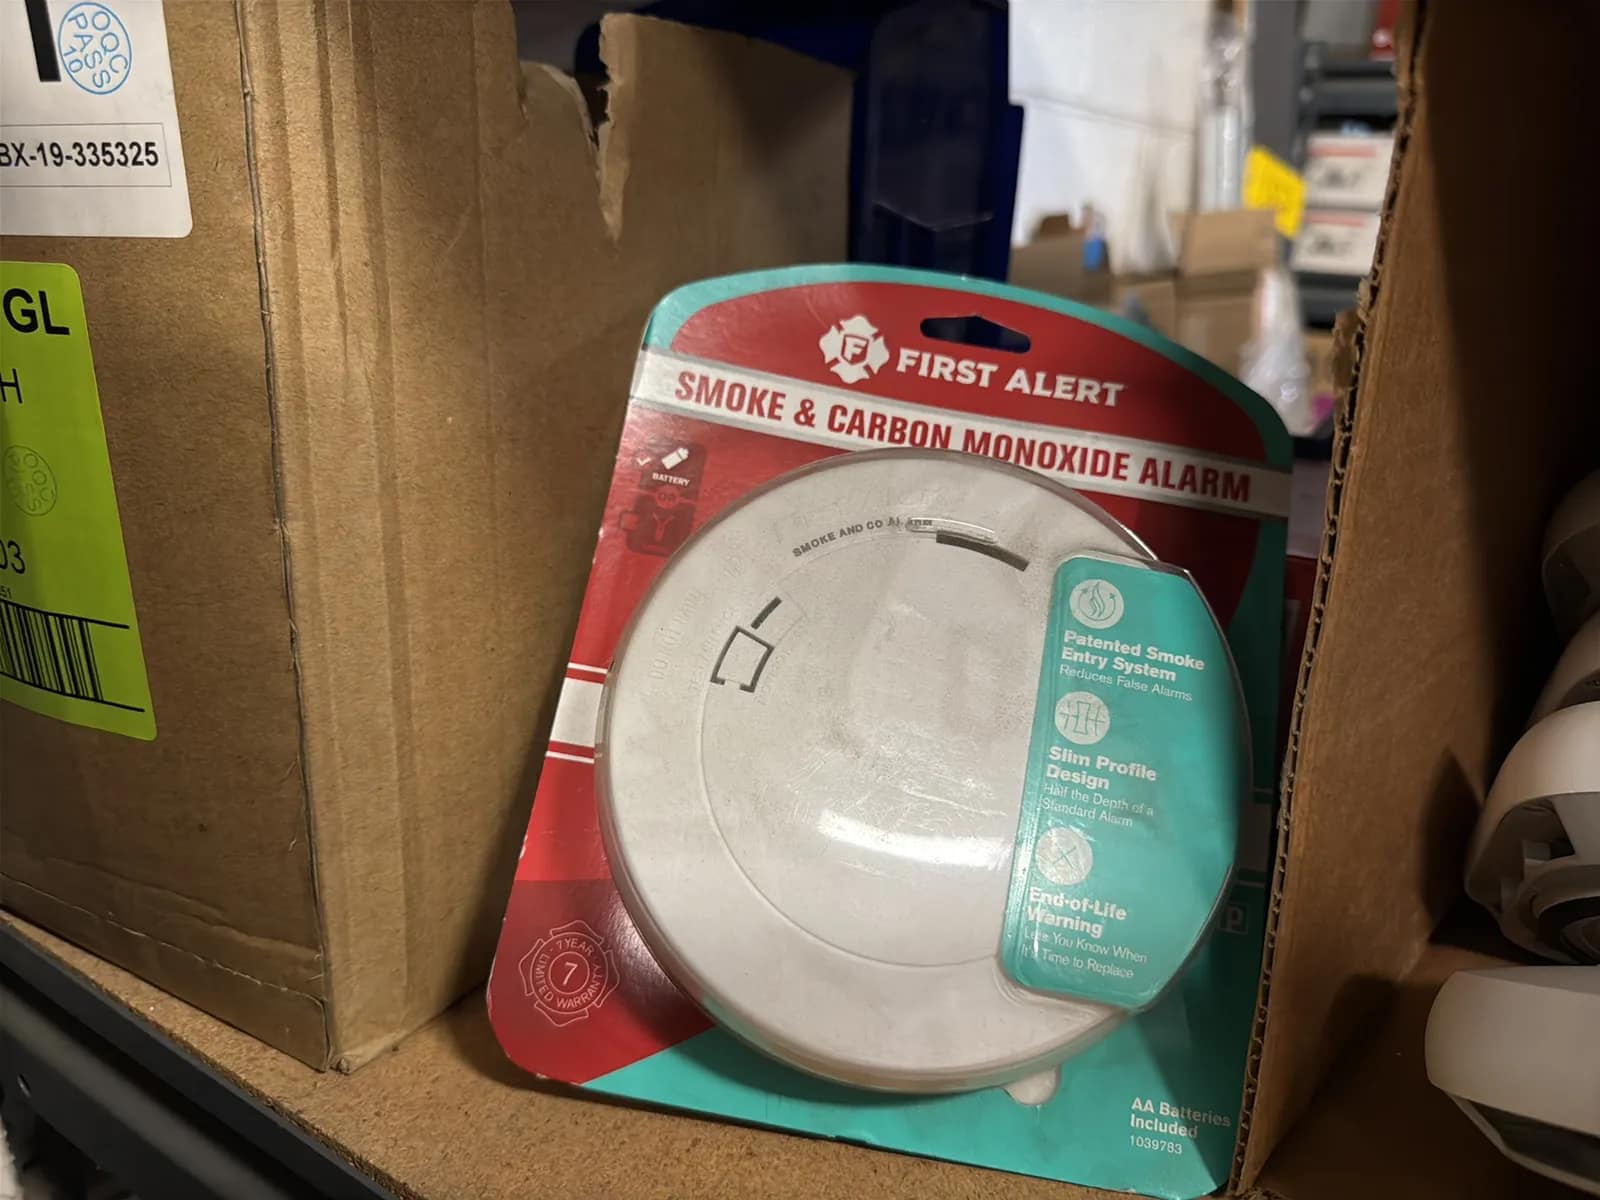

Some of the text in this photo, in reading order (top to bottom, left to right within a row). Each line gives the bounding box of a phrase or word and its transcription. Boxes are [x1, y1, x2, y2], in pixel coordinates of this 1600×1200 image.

[68, 12, 111, 88] PASS
[92, 11, 128, 75] OQC
[64, 47, 84, 74] 10
[897, 348, 1126, 407] FIRST ALERT
[675, 371, 1250, 503] SMOKE & CARBON MONOXIDE ALARM
[651, 472, 691, 487] BATTERY
[793, 532, 836, 557] SMOKE
[839, 521, 864, 538] AND
[866, 519, 883, 530] CO
[1061, 647, 1177, 682] Entry System
[1064, 629, 1206, 671] Patented Smoke
[1059, 664, 1193, 702] Reduces False Alarms
[1046, 764, 1110, 790] Design
[1048, 746, 1157, 782] Slim Profile
[1040, 796, 1133, 828] Standard Alarm
[1043, 784, 1154, 816] Half the Depth of a
[1028, 885, 1128, 921] End-of-Life
[1027, 906, 1104, 938] Warning
[1042, 948, 1070, 965] Time
[1073, 955, 1084, 968] to
[1087, 959, 1134, 980] Replace
[1052, 931, 1073, 948] You
[1076, 936, 1110, 955] Know
[1112, 946, 1148, 964] When
[535, 953, 602, 1009] LIMITED WARRANTY
[562, 961, 578, 986] 7
[1130, 1113, 1198, 1138] Included
[1131, 1097, 1232, 1127] AA Batteries
[1130, 1135, 1183, 1154] 1039783
